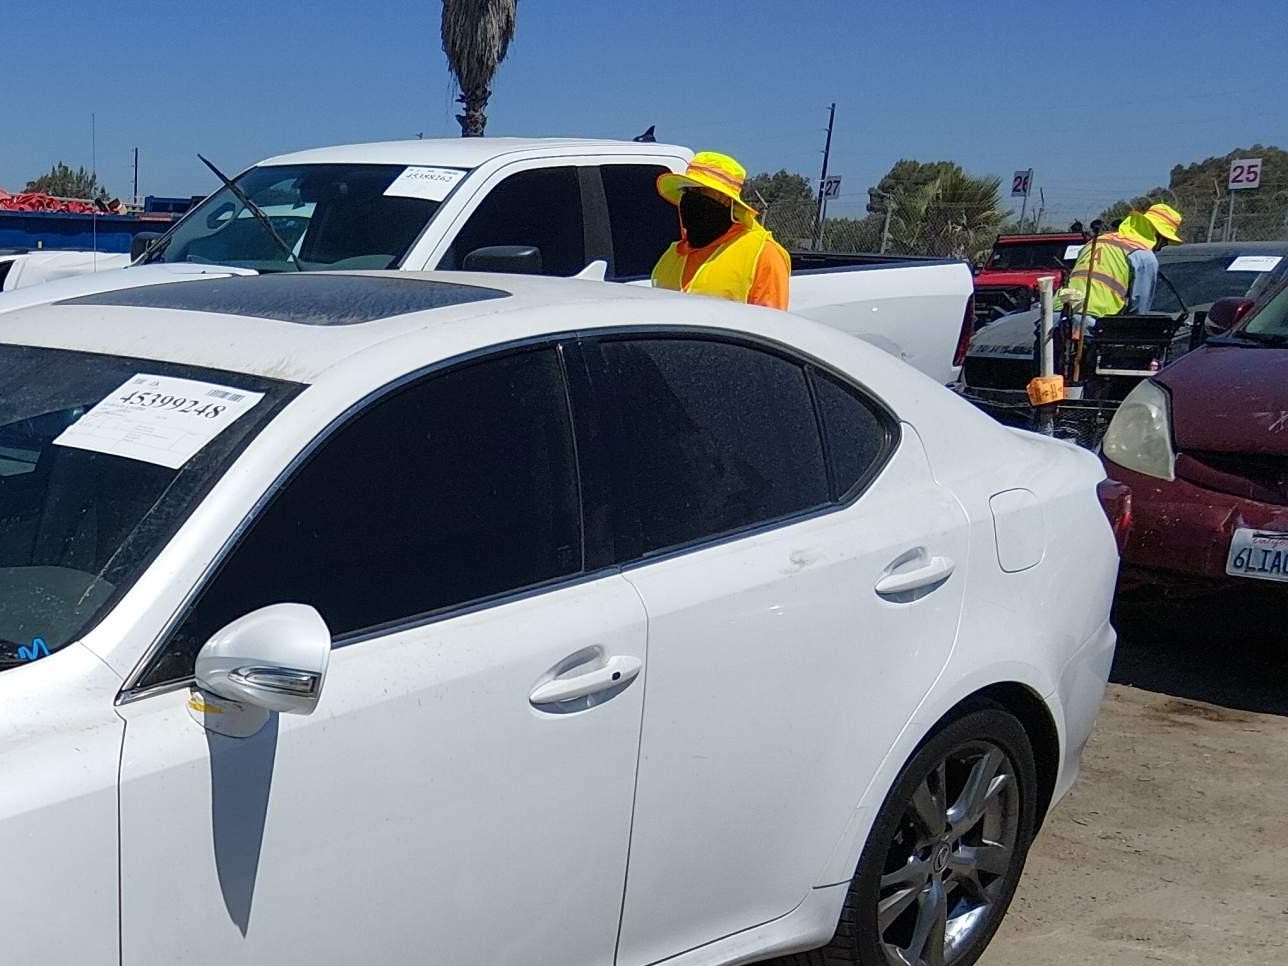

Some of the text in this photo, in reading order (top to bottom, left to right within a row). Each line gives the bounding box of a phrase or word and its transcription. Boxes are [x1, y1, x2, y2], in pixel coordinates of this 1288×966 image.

[1231, 164, 1259, 184] 25
[824, 180, 841, 196] 27
[1012, 175, 1029, 193] 26
[120, 390, 227, 420] 45399248
